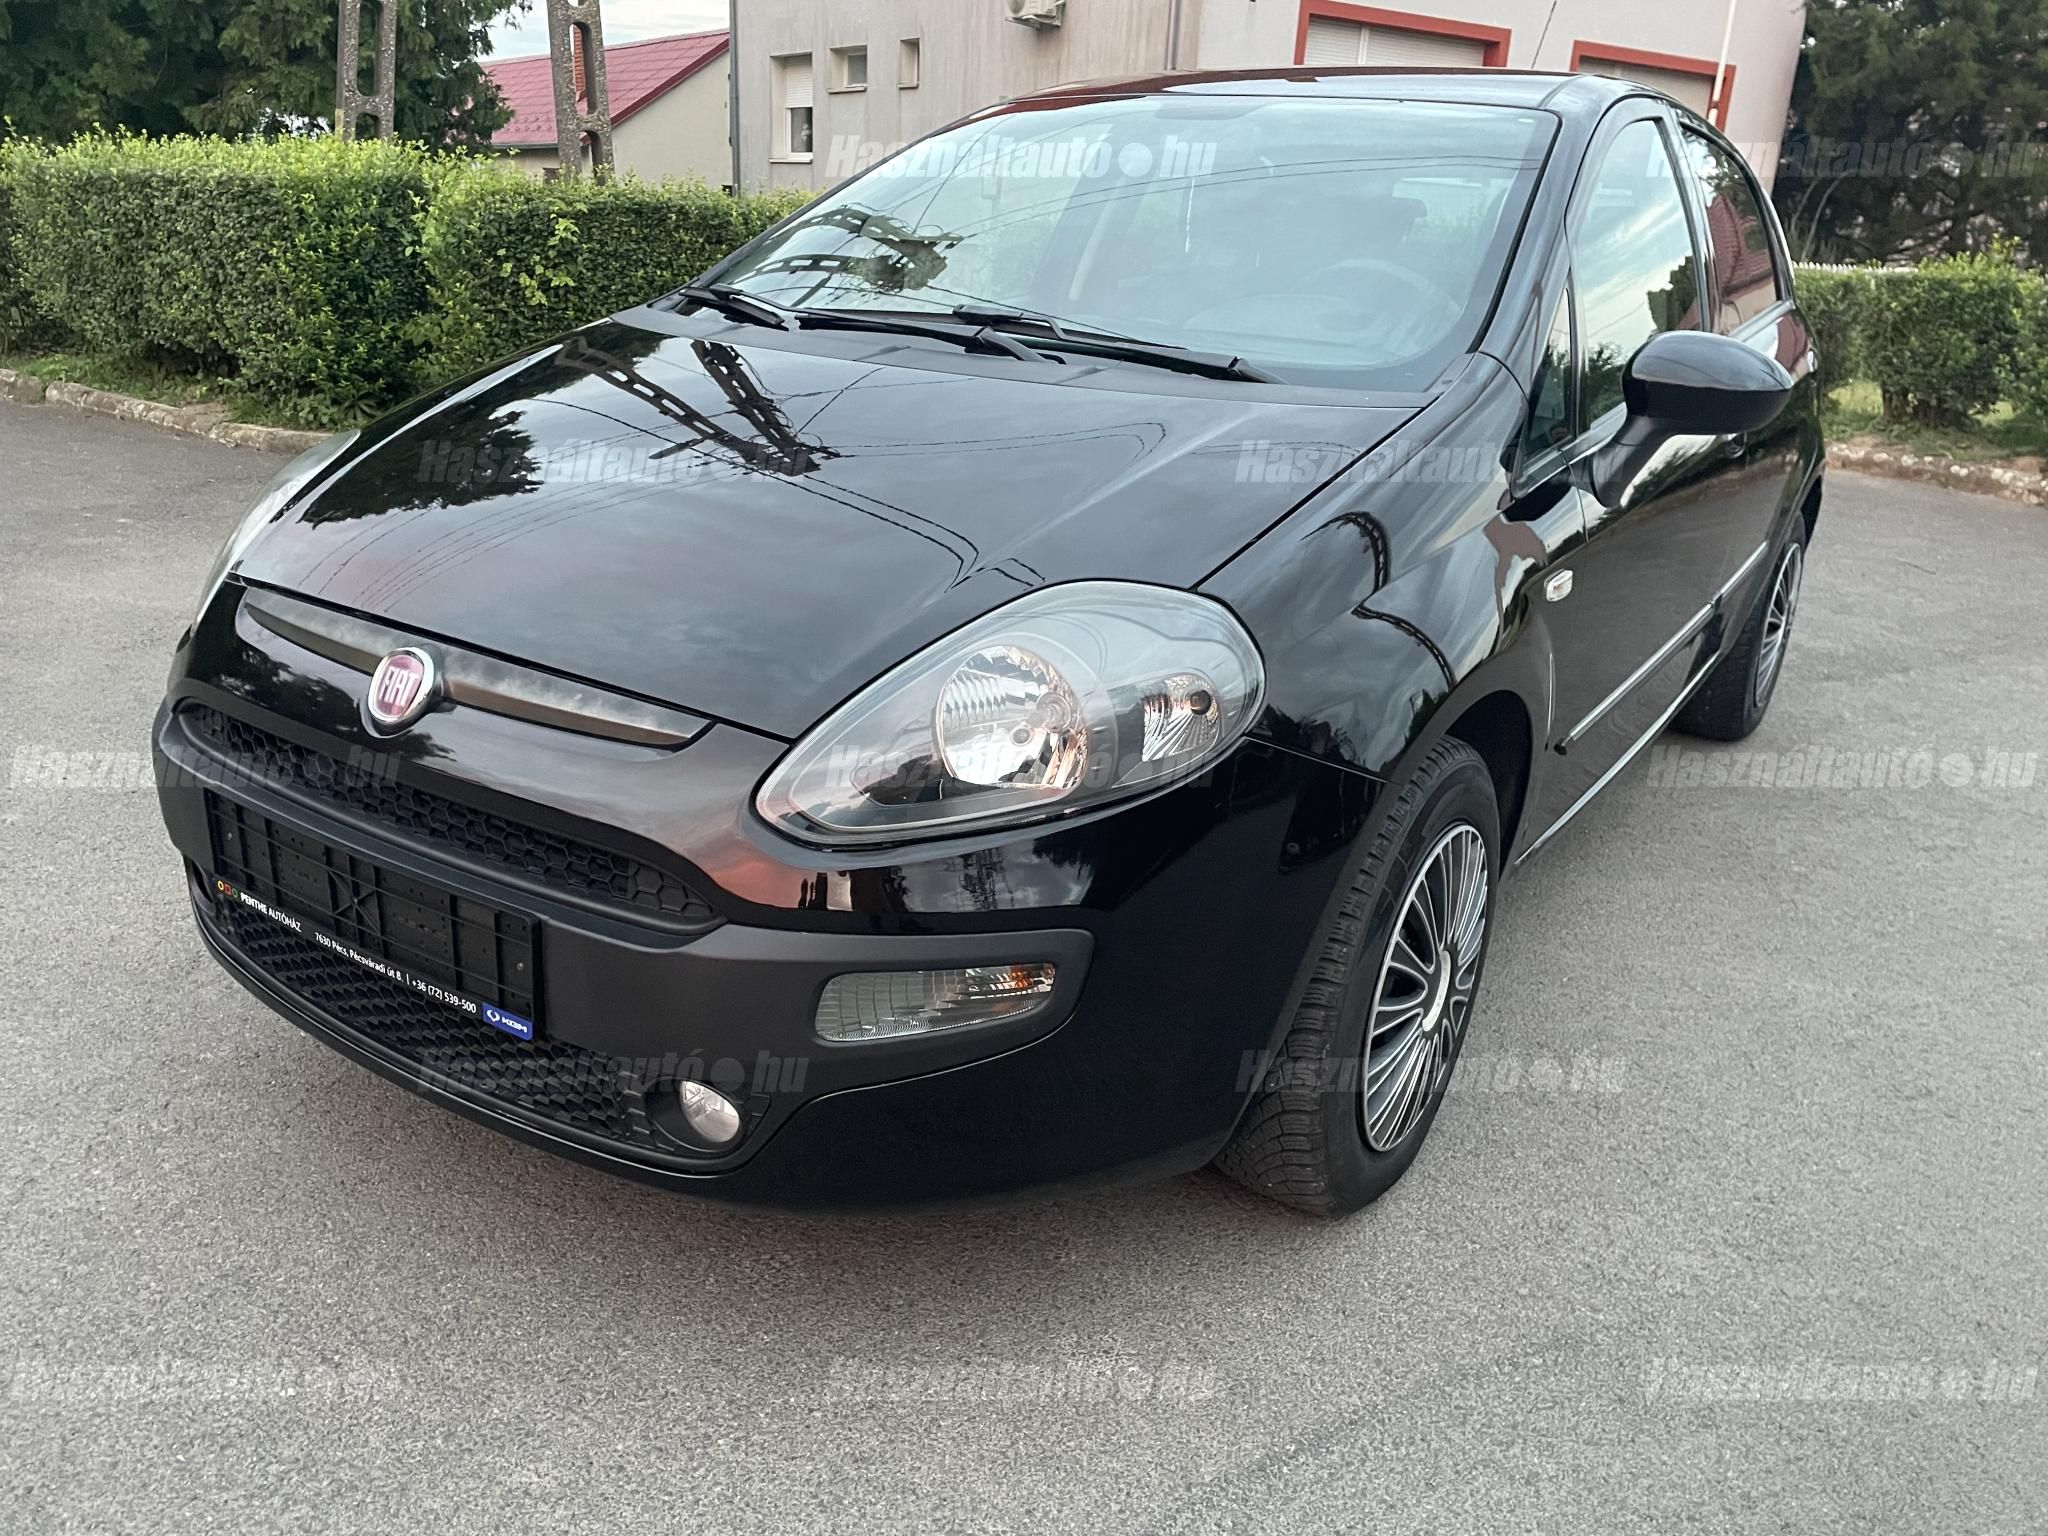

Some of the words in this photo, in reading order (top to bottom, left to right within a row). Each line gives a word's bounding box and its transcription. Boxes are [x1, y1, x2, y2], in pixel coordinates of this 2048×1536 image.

[379, 665, 420, 707] FIAT
[269, 907, 302, 932] AUTÓHÁZ
[314, 931, 331, 948] 7630
[412, 979, 426, 992] +36
[427, 984, 443, 1000] (72)
[444, 991, 477, 1014] 539-500
